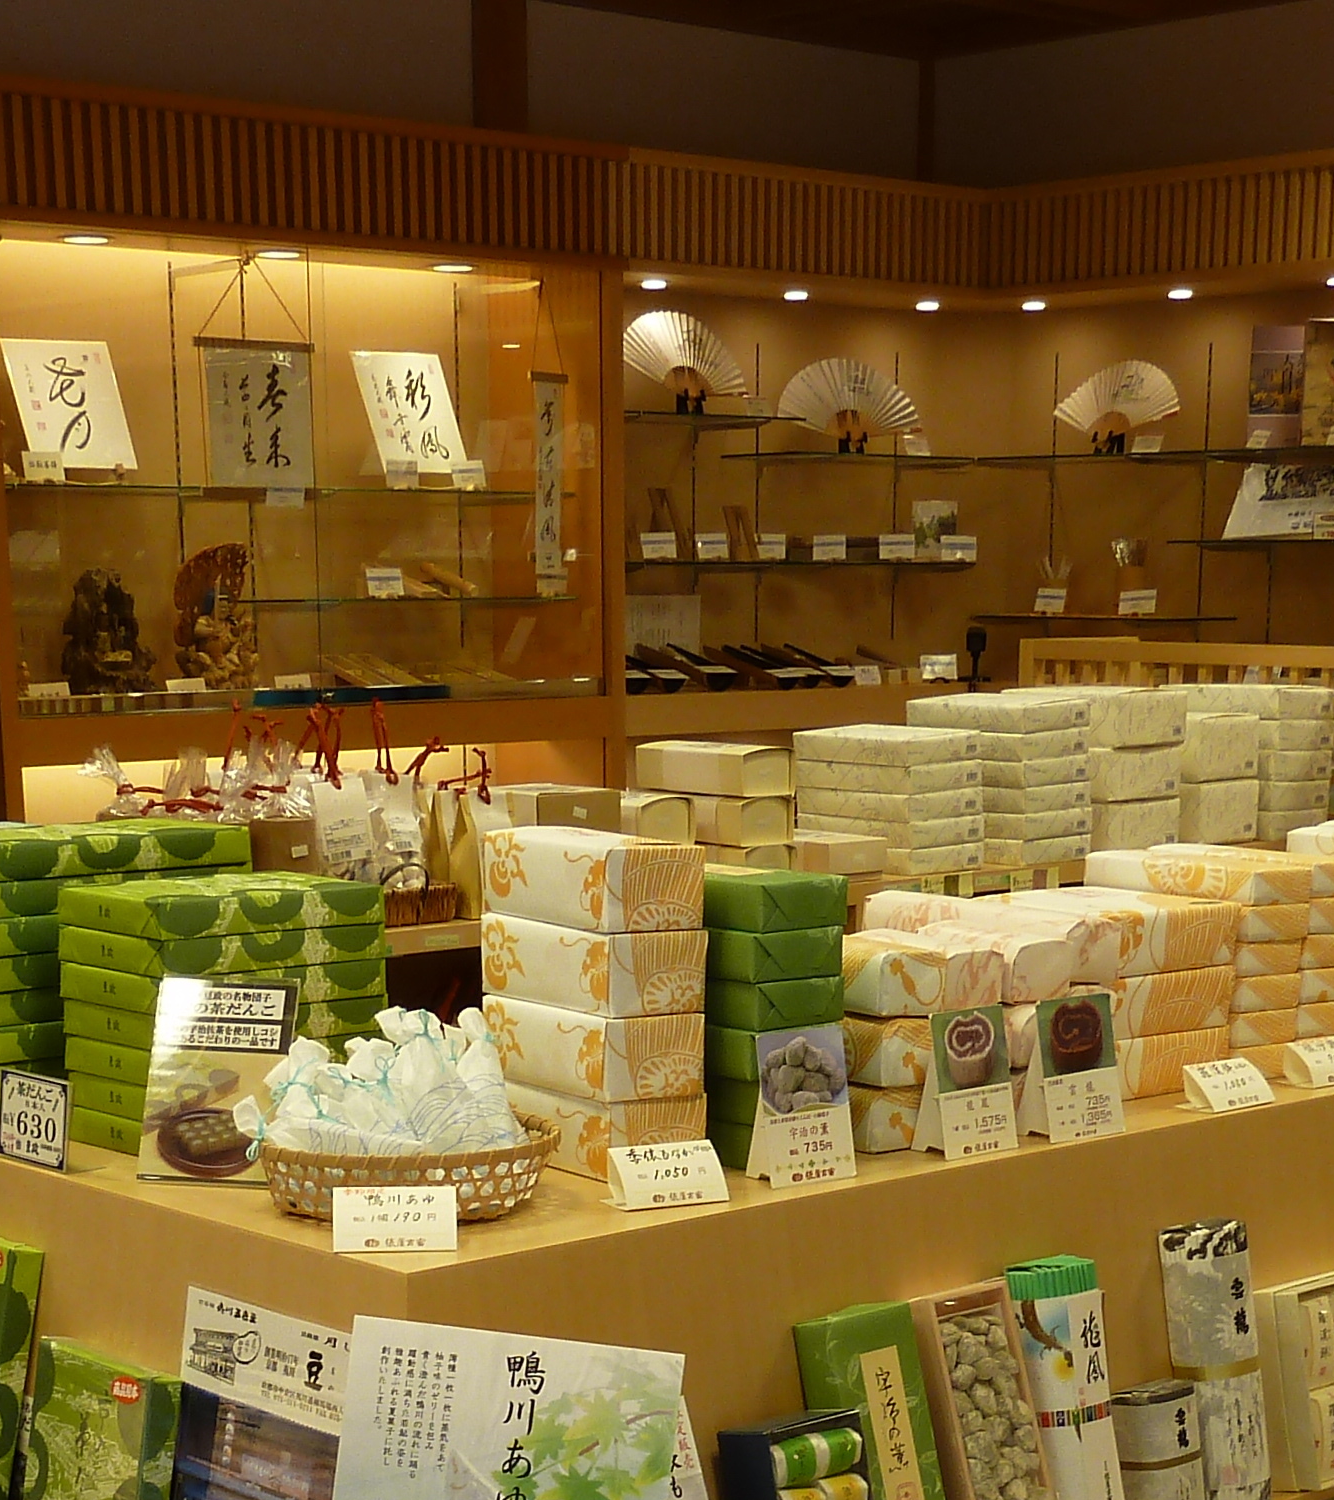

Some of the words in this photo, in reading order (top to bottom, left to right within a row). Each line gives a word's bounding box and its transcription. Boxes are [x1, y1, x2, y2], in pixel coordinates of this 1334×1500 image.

[16, 1081, 54, 1102] 茶だんご
[16, 1111, 57, 1143] 630
[789, 1122, 829, 1140] 宇治の薫
[804, 1140, 832, 1154] 735円
[364, 1194, 434, 1206] 鴨川あゆ
[394, 1212, 420, 1222] 190
[427, 1213, 436, 1221] 円
[1230, 1277, 1249, 1335] 雲龍
[1080, 1310, 1105, 1385] 龍鳳
[1174, 1407, 1189, 1450] 雲龍
